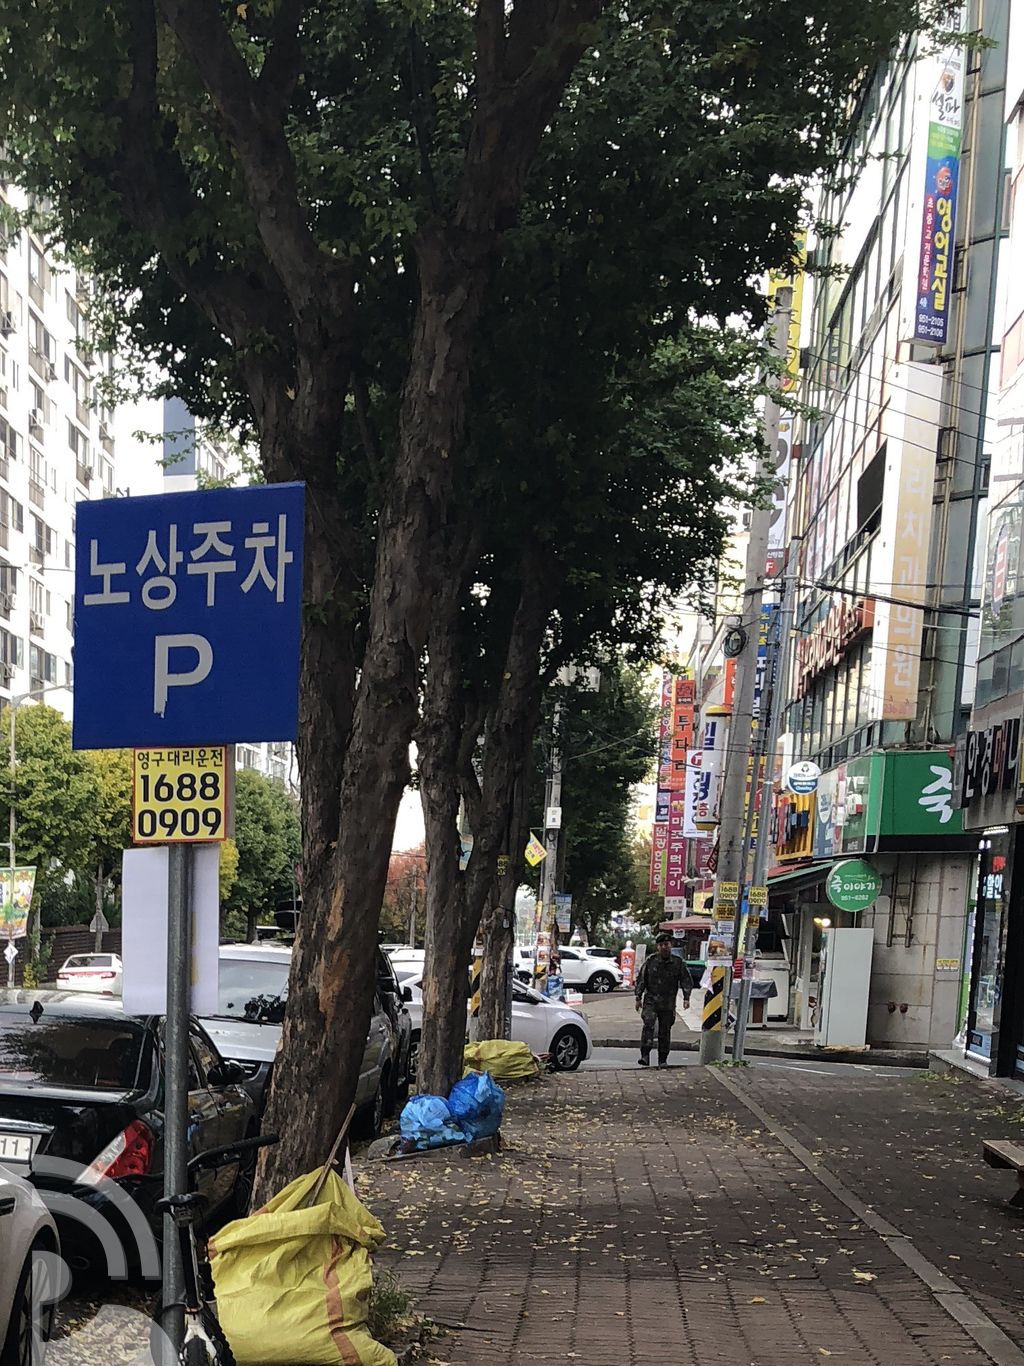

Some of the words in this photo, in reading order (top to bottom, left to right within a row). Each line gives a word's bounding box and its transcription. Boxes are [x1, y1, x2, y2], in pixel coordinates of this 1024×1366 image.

[931, 197, 953, 311] 영어교실
[83, 513, 294, 610] 노상주차
[153, 633, 214, 718] P
[136, 748, 223, 770] 영구대리운전
[140, 772, 221, 803] 1688
[138, 807, 222, 838] 0909
[830, 875, 876, 893] 죽이야기
